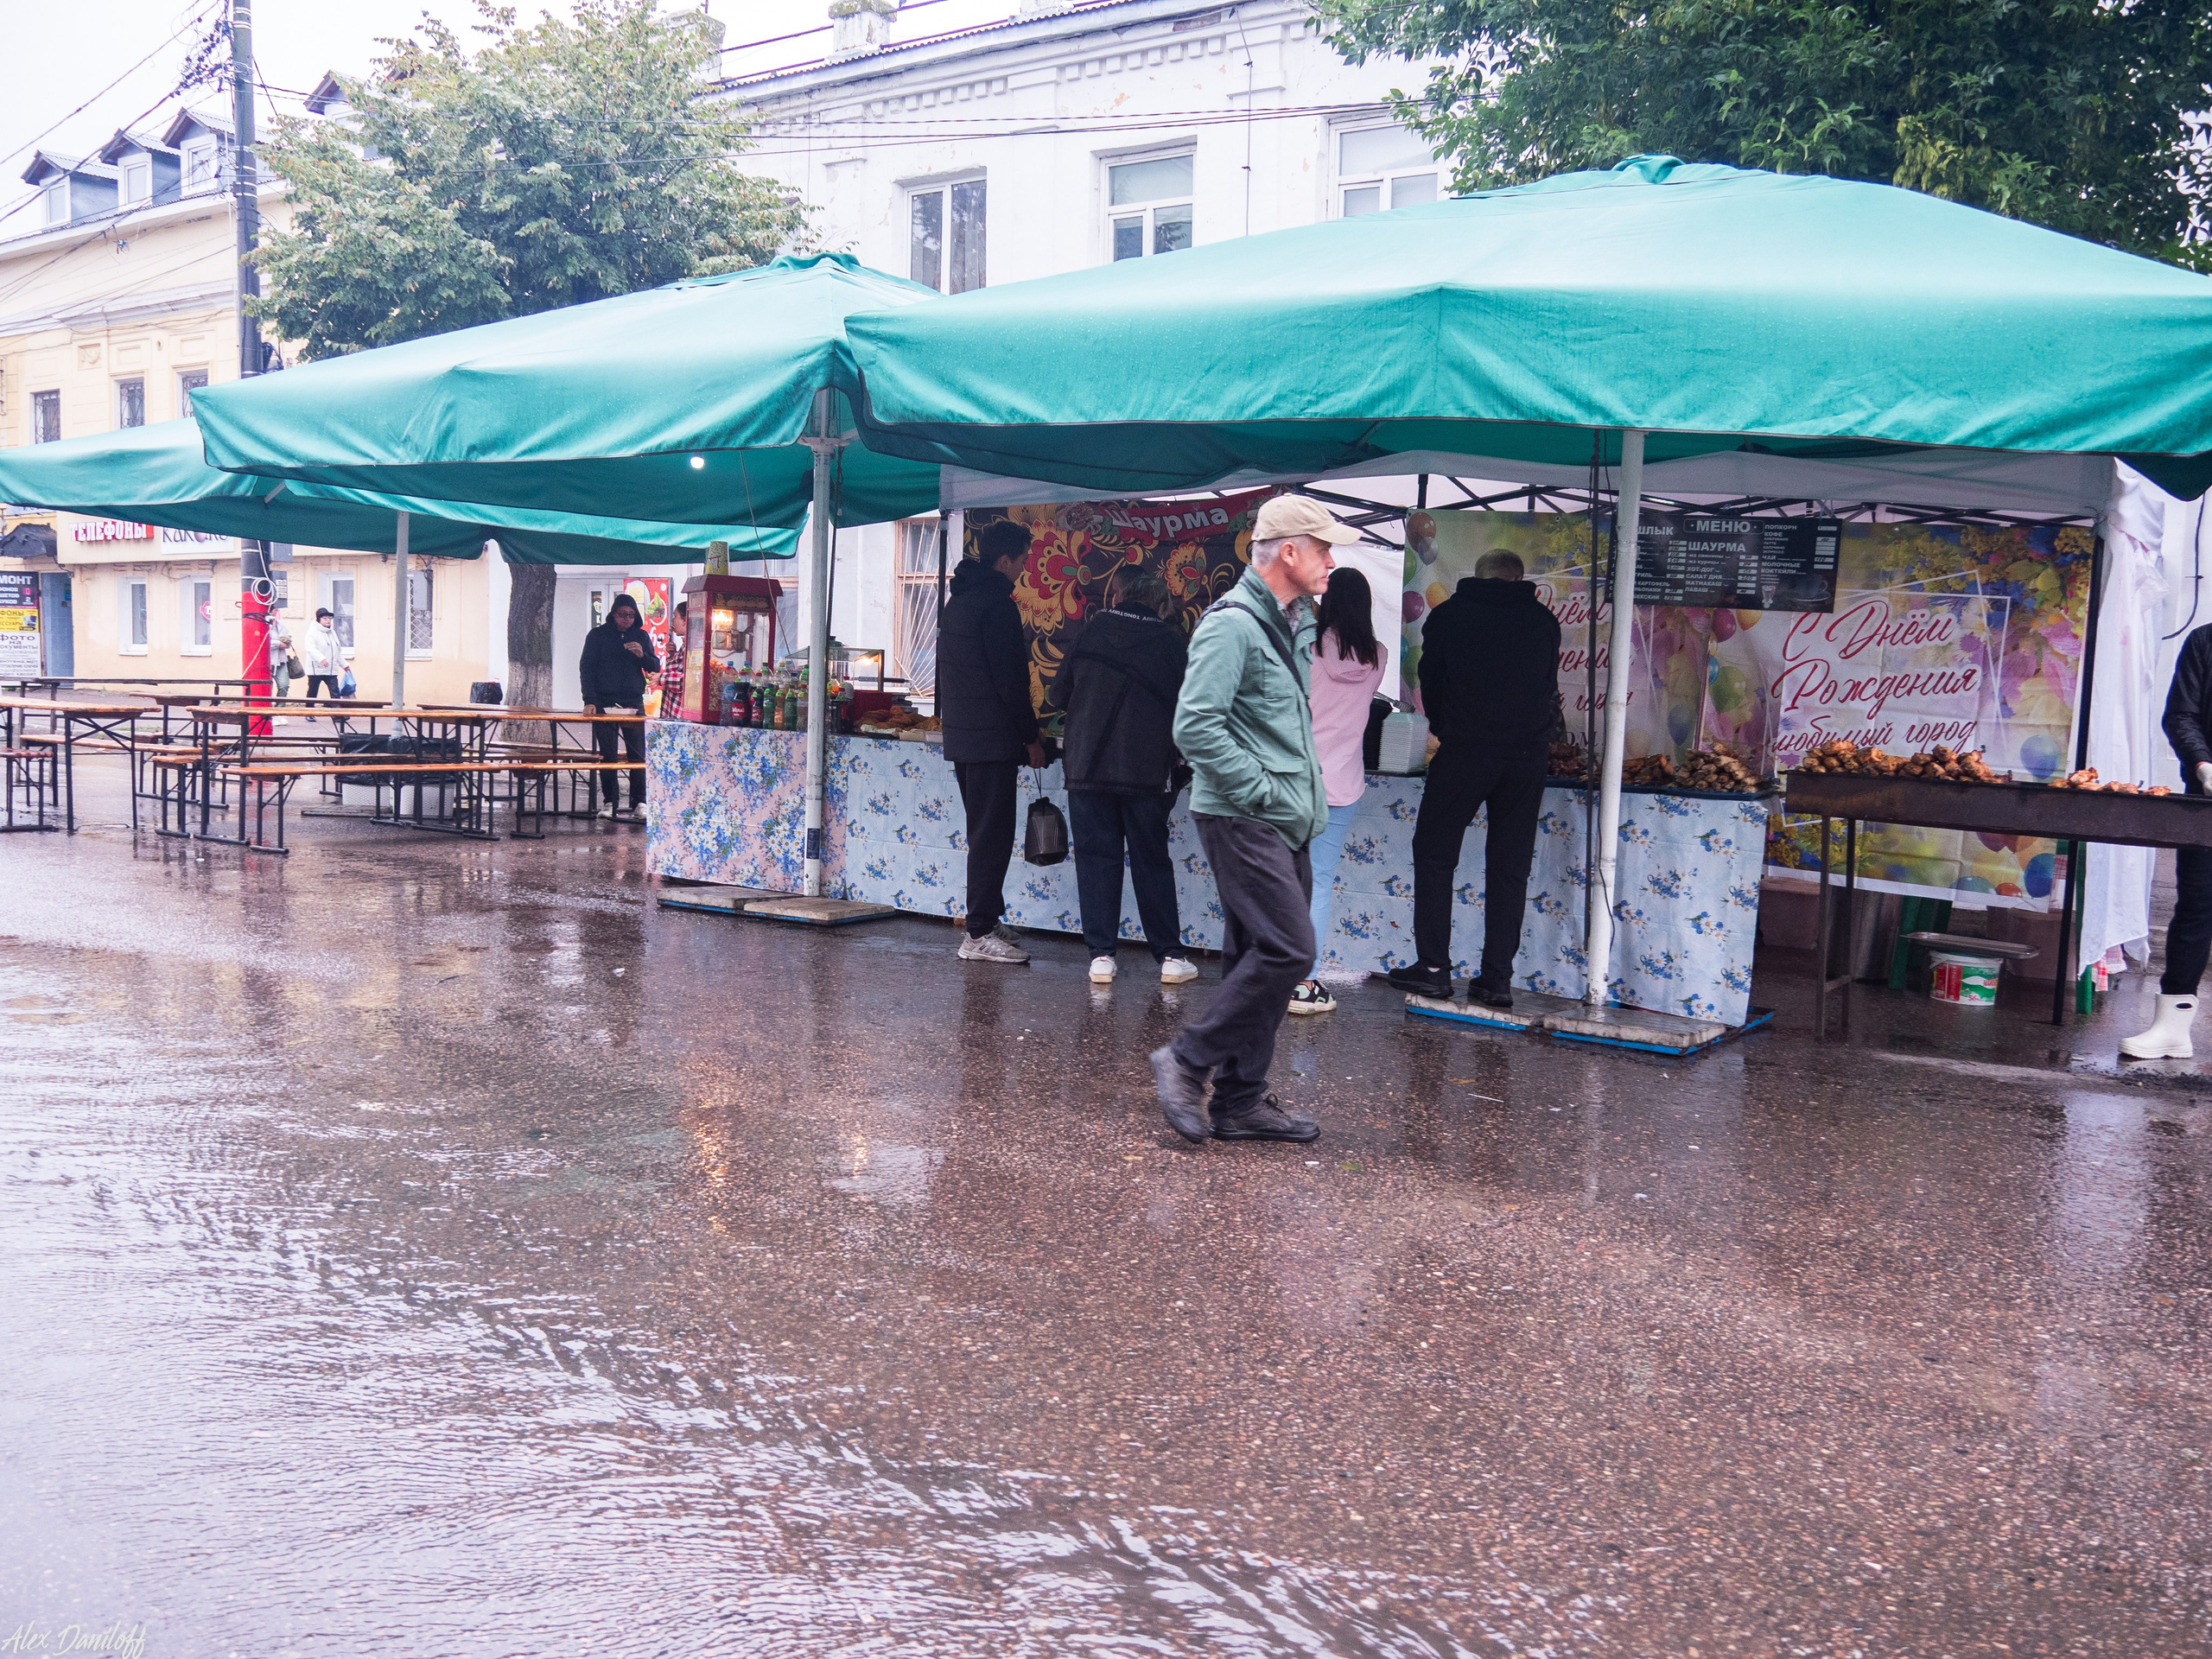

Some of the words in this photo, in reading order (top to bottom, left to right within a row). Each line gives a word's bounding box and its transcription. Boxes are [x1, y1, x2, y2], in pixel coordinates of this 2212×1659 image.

[68, 520, 147, 542] ТЕЛЕФОНЫ
[1103, 507, 1229, 538] Шаурма
[1637, 525, 1674, 536] ШЛЫК
[1696, 520, 1751, 533] МЕНЮ
[1688, 541, 1745, 552] ШАУРМА
[1825, 600, 1954, 659] Днём
[1771, 658, 1978, 720] Рождения
[1902, 721, 1978, 753] город
